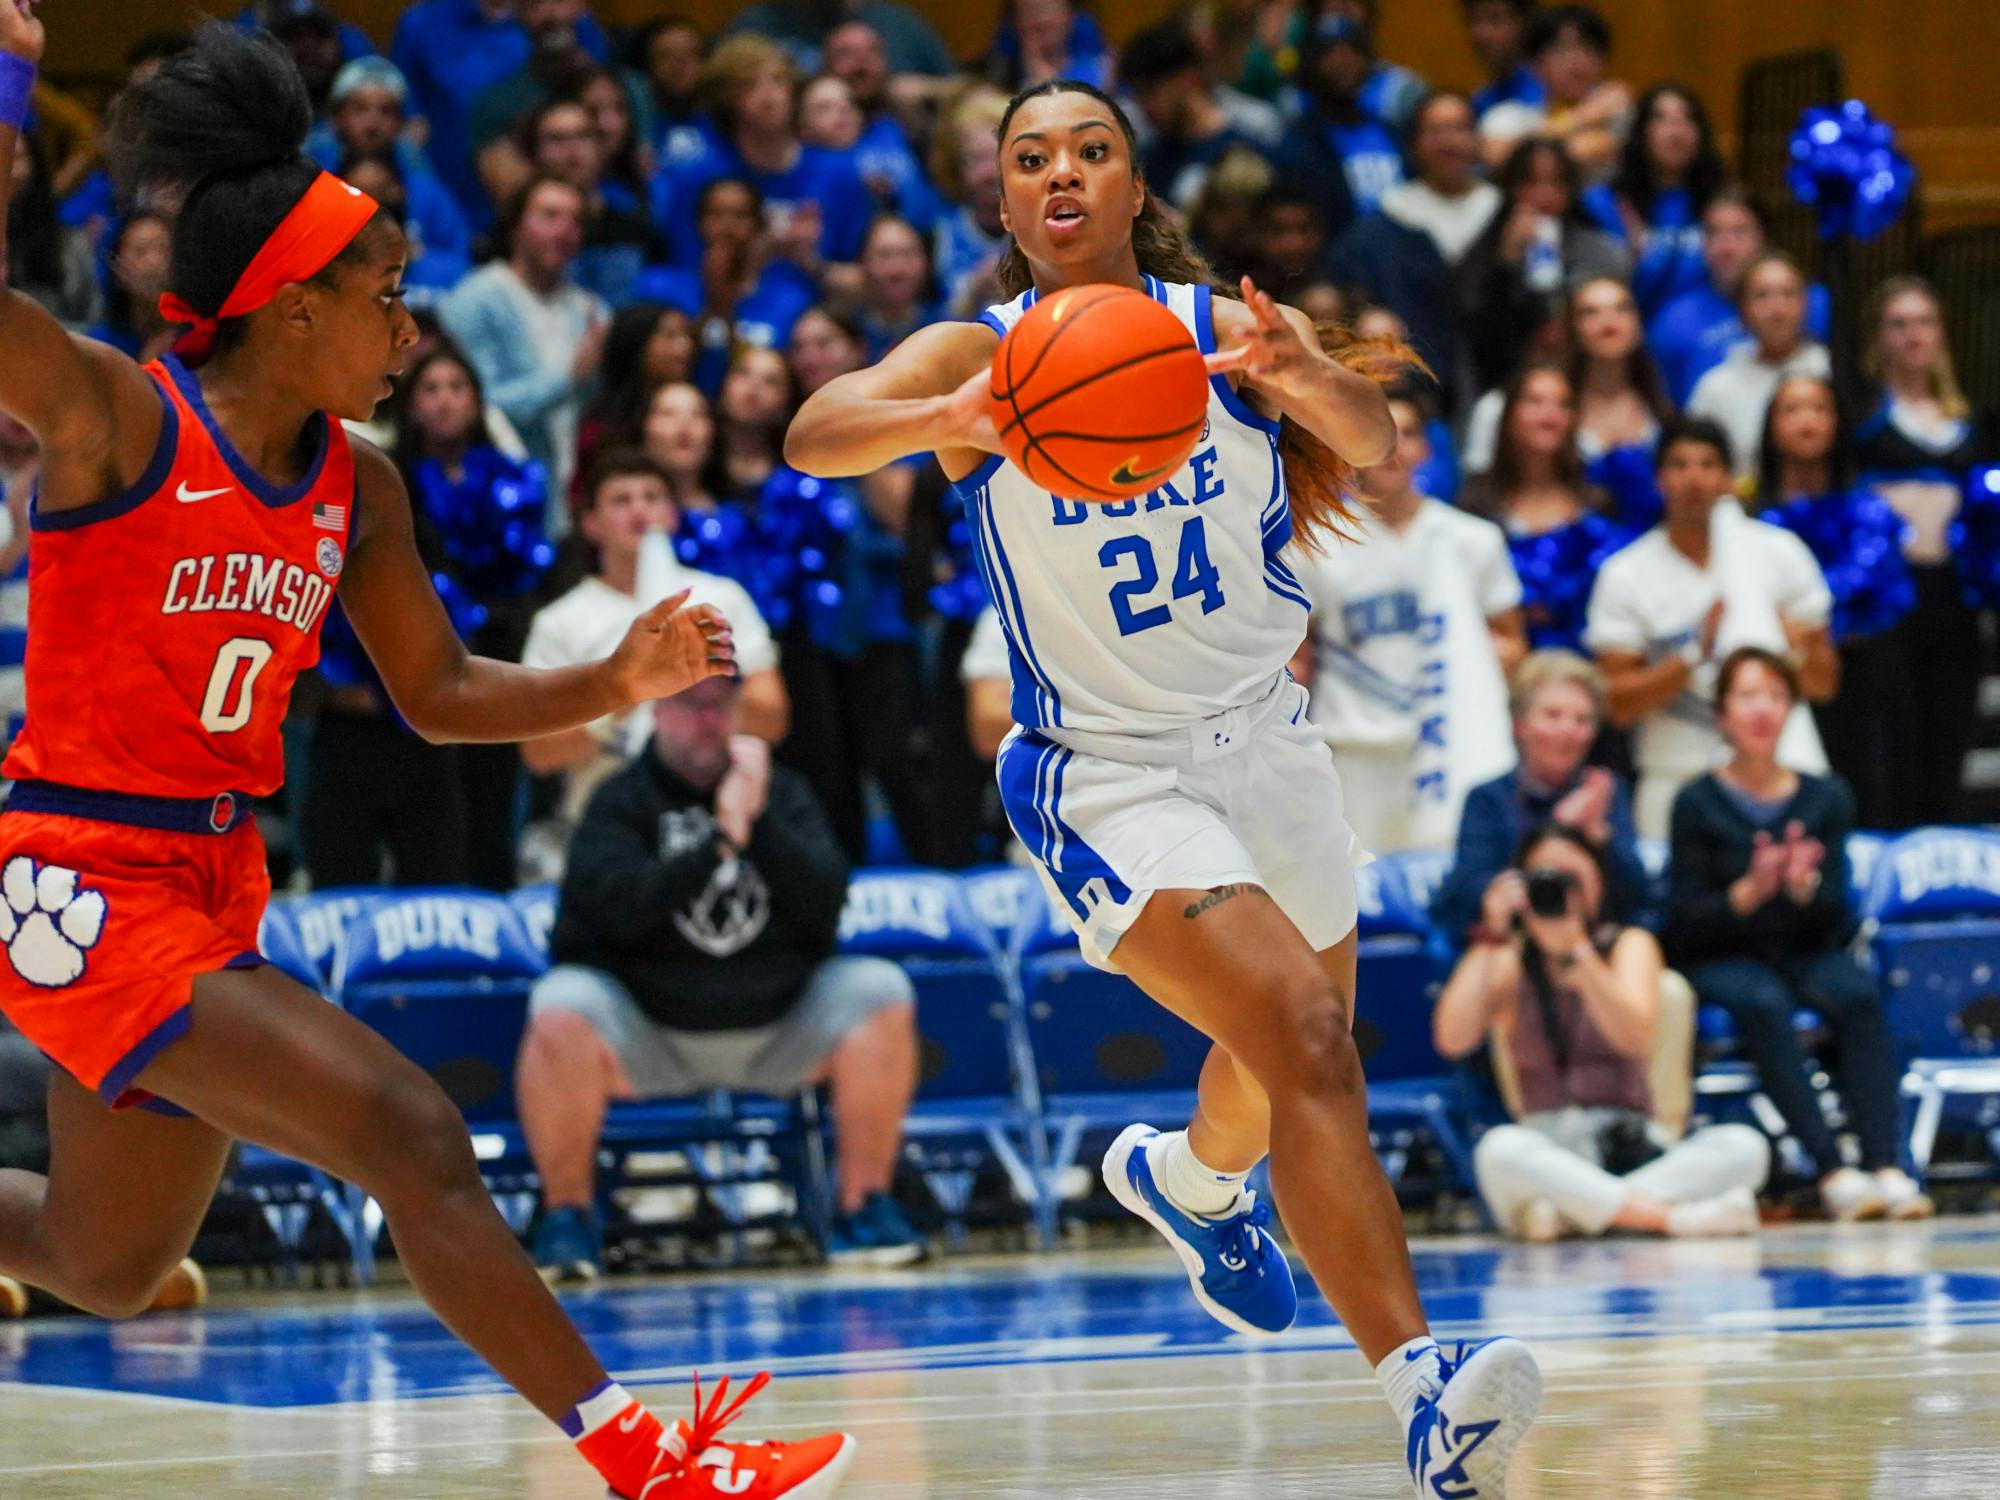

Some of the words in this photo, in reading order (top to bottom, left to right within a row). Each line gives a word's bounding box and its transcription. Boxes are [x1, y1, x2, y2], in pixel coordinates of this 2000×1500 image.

[1098, 515, 1225, 637] 24
[200, 637, 273, 734] 0
[374, 897, 499, 963] DUKE
